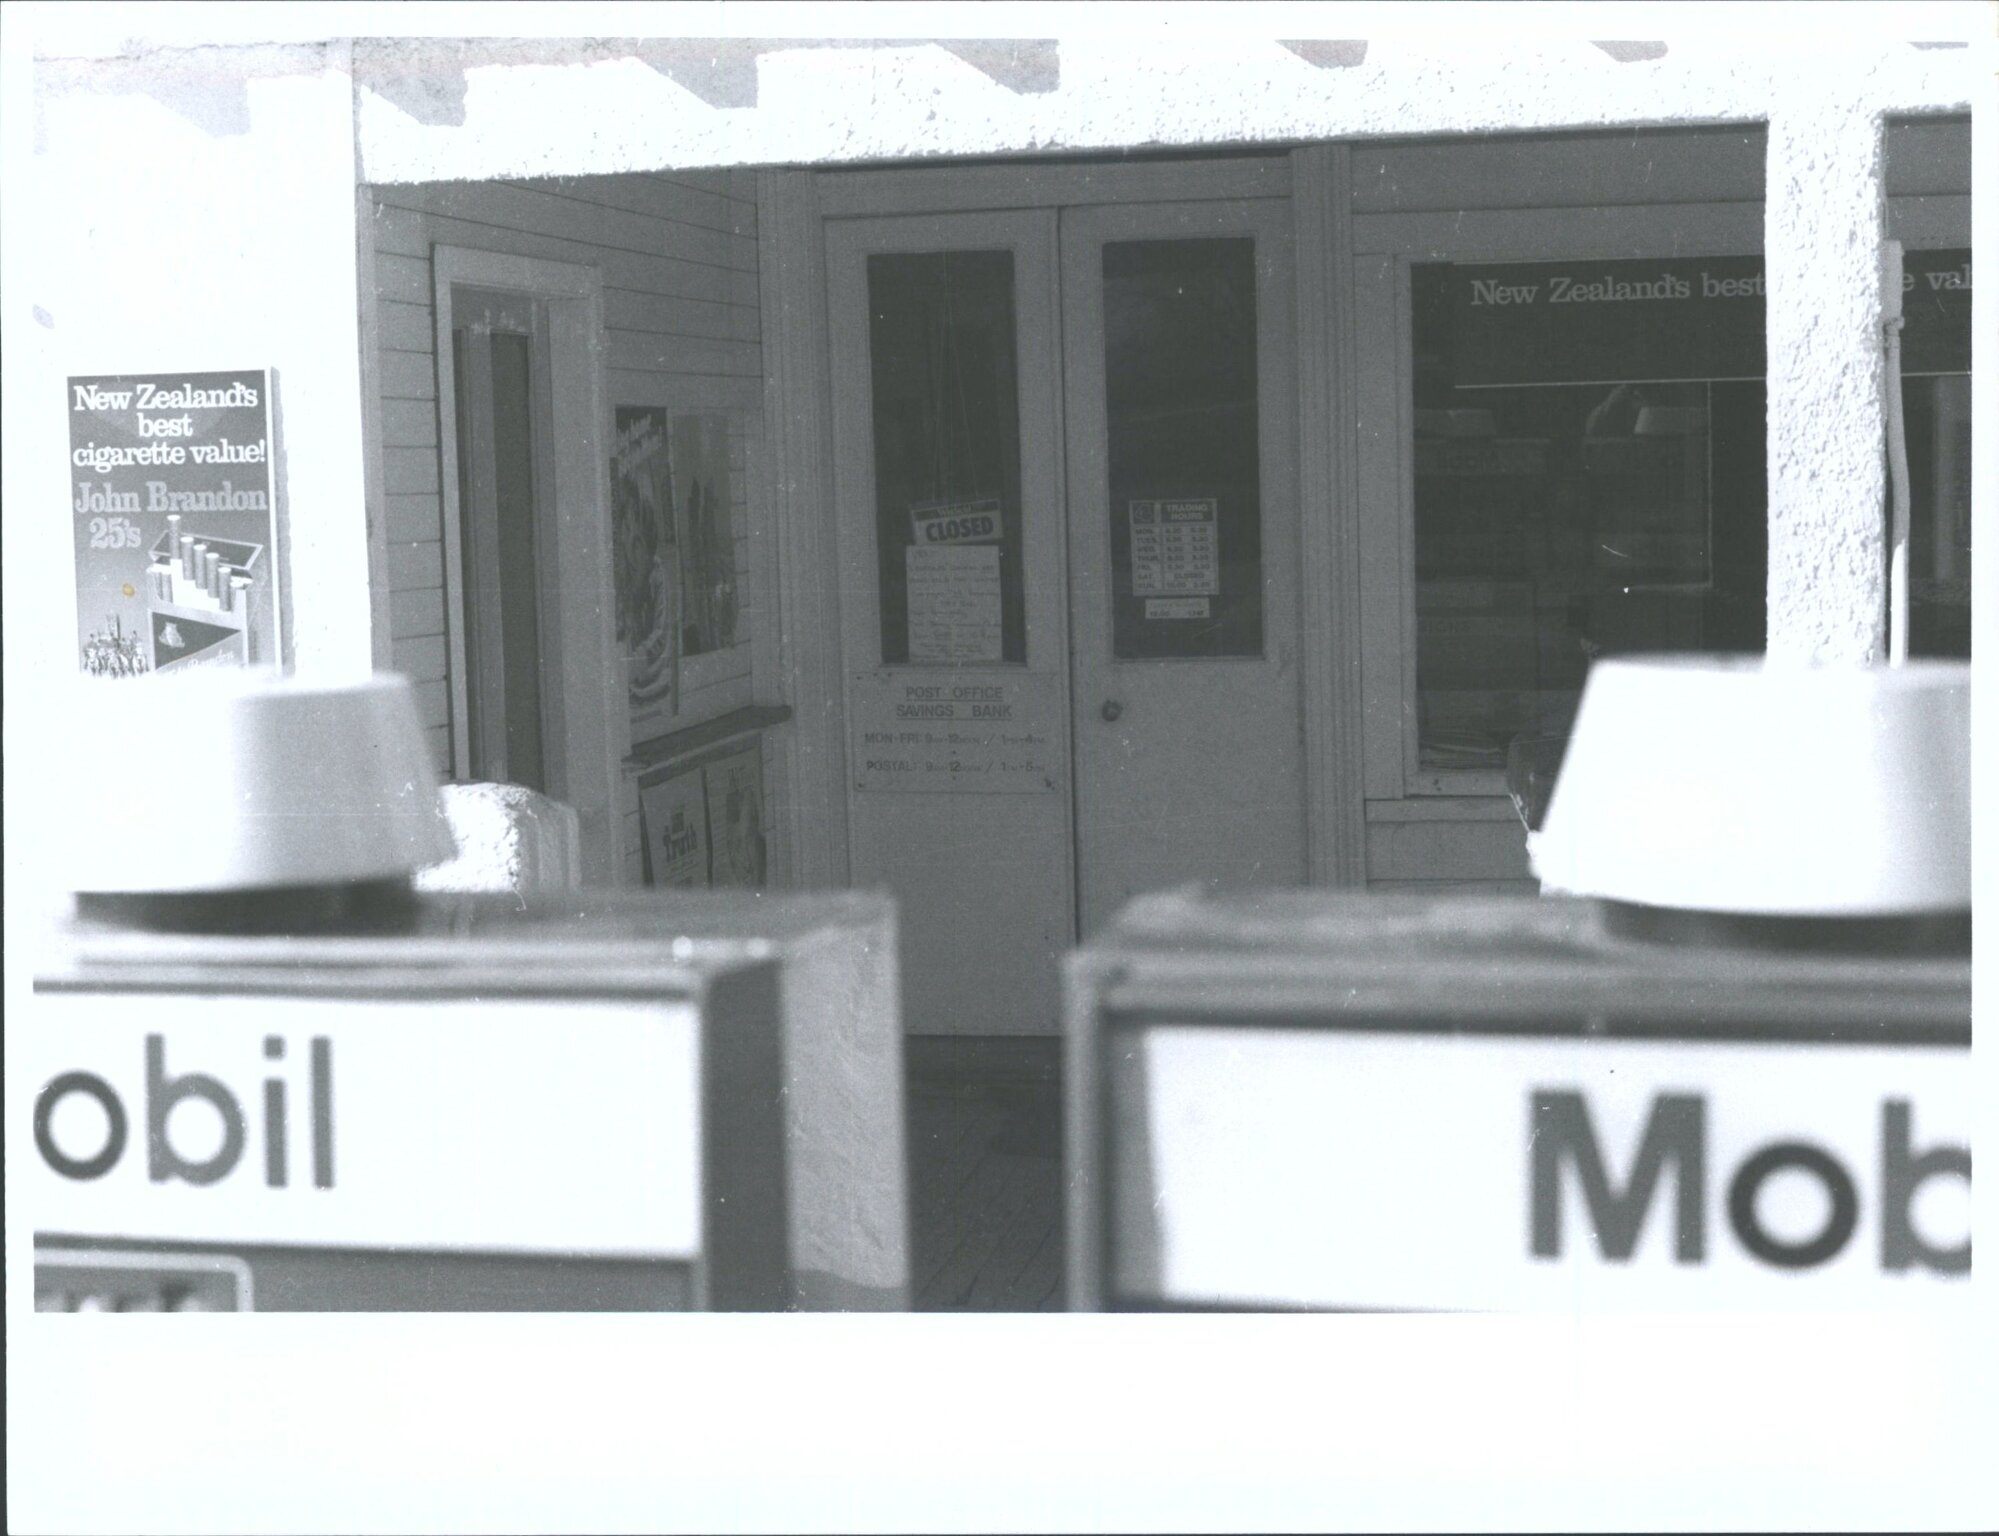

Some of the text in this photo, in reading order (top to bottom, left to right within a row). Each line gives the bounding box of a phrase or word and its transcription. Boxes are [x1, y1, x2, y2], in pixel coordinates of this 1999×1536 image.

[1470, 279, 1538, 306] New
[1549, 273, 1691, 303] Zealand's
[1702, 272, 1765, 299] best
[73, 382, 258, 411] New Zealand's
[137, 413, 194, 438] best
[73, 438, 266, 473] cigarette value!
[75, 481, 267, 513] John Brandon
[1166, 503, 1208, 512] TRADING
[926, 516, 993, 542] CLOSED
[1171, 512, 1203, 521] HOURS
[89, 518, 141, 549] 25's
[906, 686, 1003, 698] POST OFFICE
[896, 704, 1012, 717] SAVINGS BANK
[33, 1032, 336, 1190] obil
[1526, 1084, 1972, 1281] Mob
